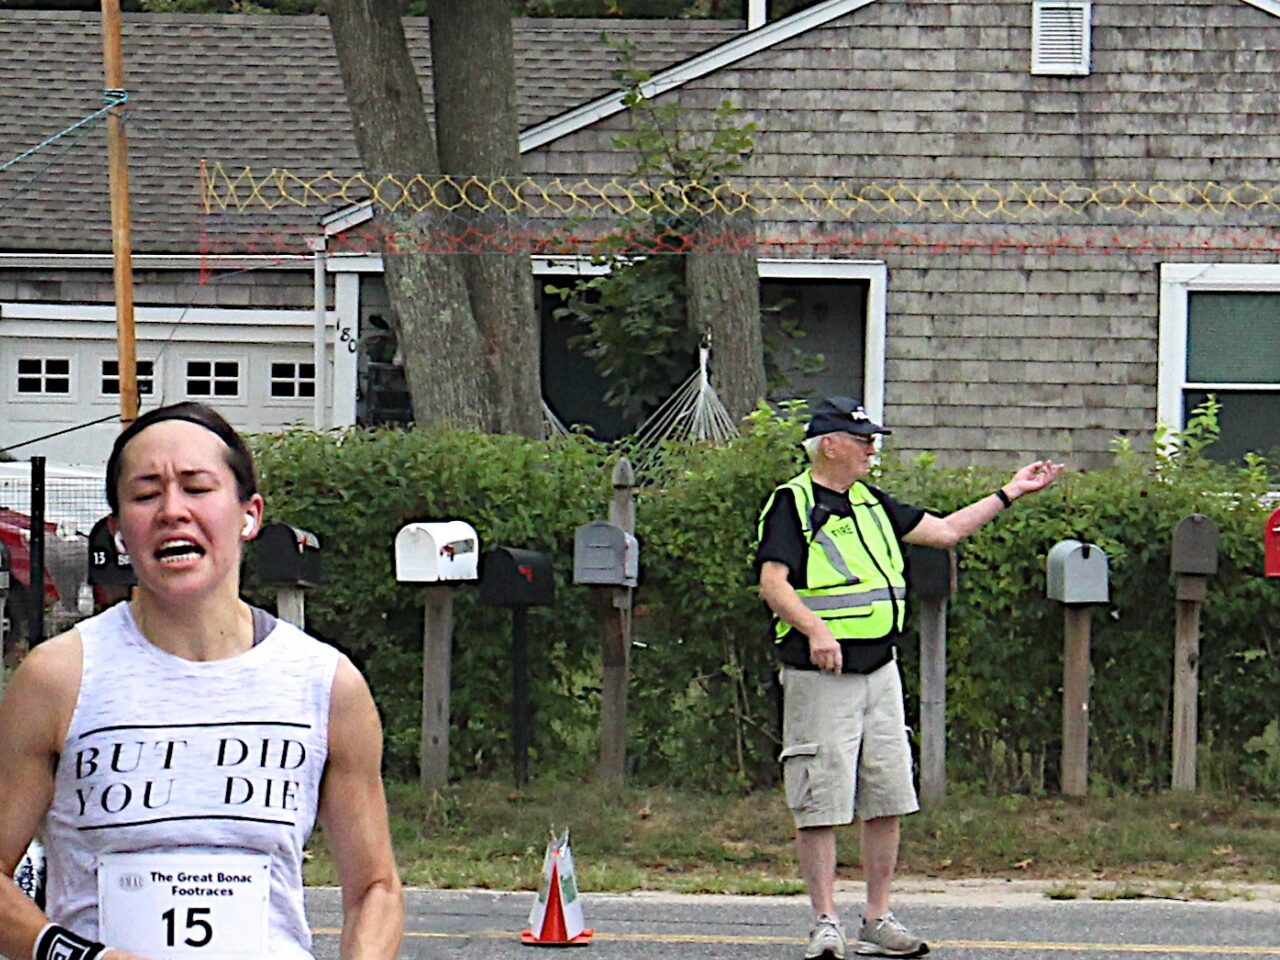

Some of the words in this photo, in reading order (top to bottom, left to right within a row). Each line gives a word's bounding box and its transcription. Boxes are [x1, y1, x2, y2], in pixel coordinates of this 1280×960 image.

[336, 319, 357, 353] 180
[831, 524, 854, 538] FIRE
[75, 741, 188, 779] BUT
[216, 738, 306, 769] DID
[76, 779, 176, 816] YOU
[224, 776, 300, 811] DIE
[150, 871, 173, 883] The
[177, 872, 213, 883] Great
[217, 872, 253, 883] Bonac
[171, 886, 234, 896] Footraces
[162, 907, 213, 948] 15
